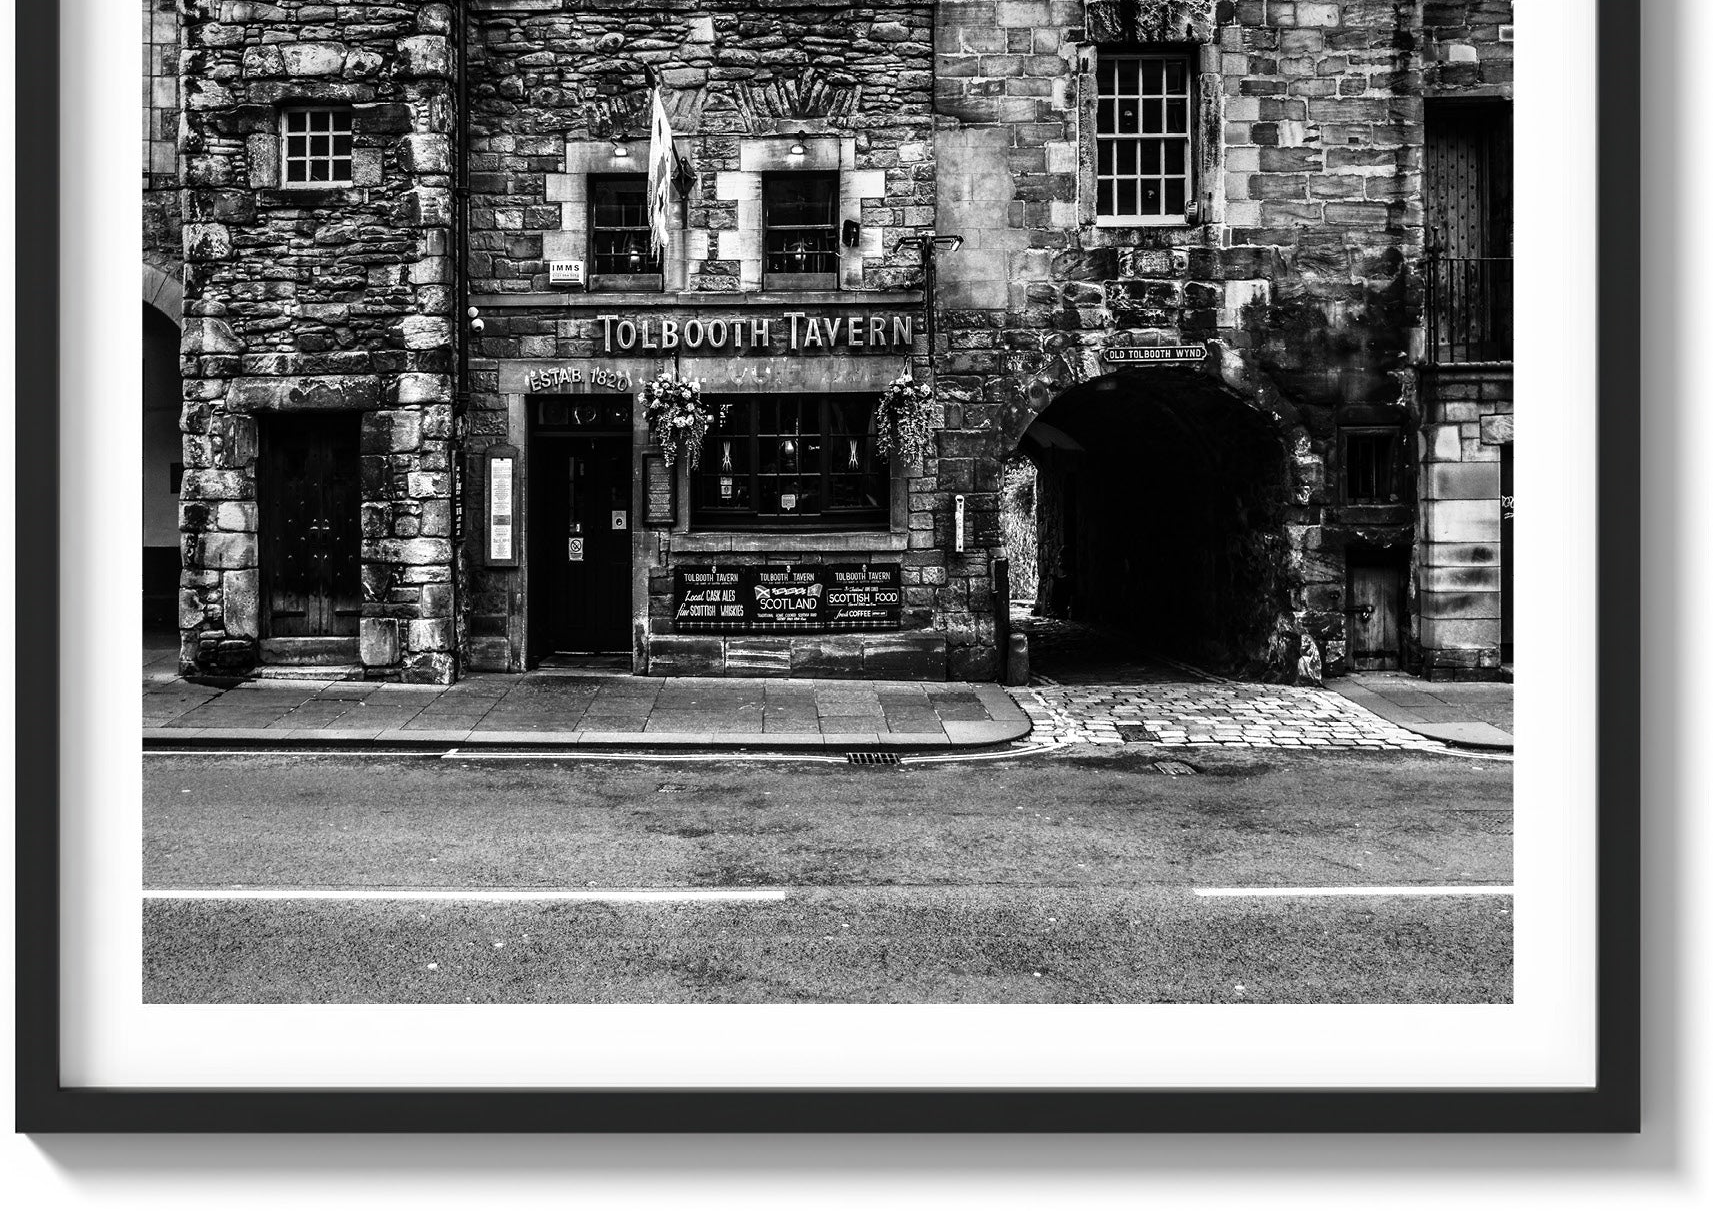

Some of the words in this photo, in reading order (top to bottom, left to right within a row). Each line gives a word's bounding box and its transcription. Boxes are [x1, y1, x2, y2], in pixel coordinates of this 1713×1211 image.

[552, 264, 580, 272] IMMS
[597, 314, 769, 352] TOLBOOTH
[784, 312, 913, 350] TAVERN
[1109, 350, 1125, 359] OLD
[1128, 349, 1171, 359] TOLBOOTH
[1175, 348, 1201, 358] WYND
[591, 370, 628, 392] 1820
[684, 573, 714, 582] TOLBOOTH
[716, 573, 739, 582] TAVERN
[760, 572, 789, 582] TOLBOOTH
[793, 572, 815, 581] TAVERN
[835, 572, 867, 581] TOLBOOTH
[868, 571, 891, 580] TAVERN
[685, 590, 705, 602] Local
[706, 589, 721, 602] CASK
[722, 589, 736, 602] ALES
[829, 593, 870, 605] SCOTTISH
[875, 592, 898, 602] FOOD
[760, 598, 817, 610] SCOTLAND
[690, 604, 716, 617] SCOTTISH
[849, 610, 871, 618] COFFEE
